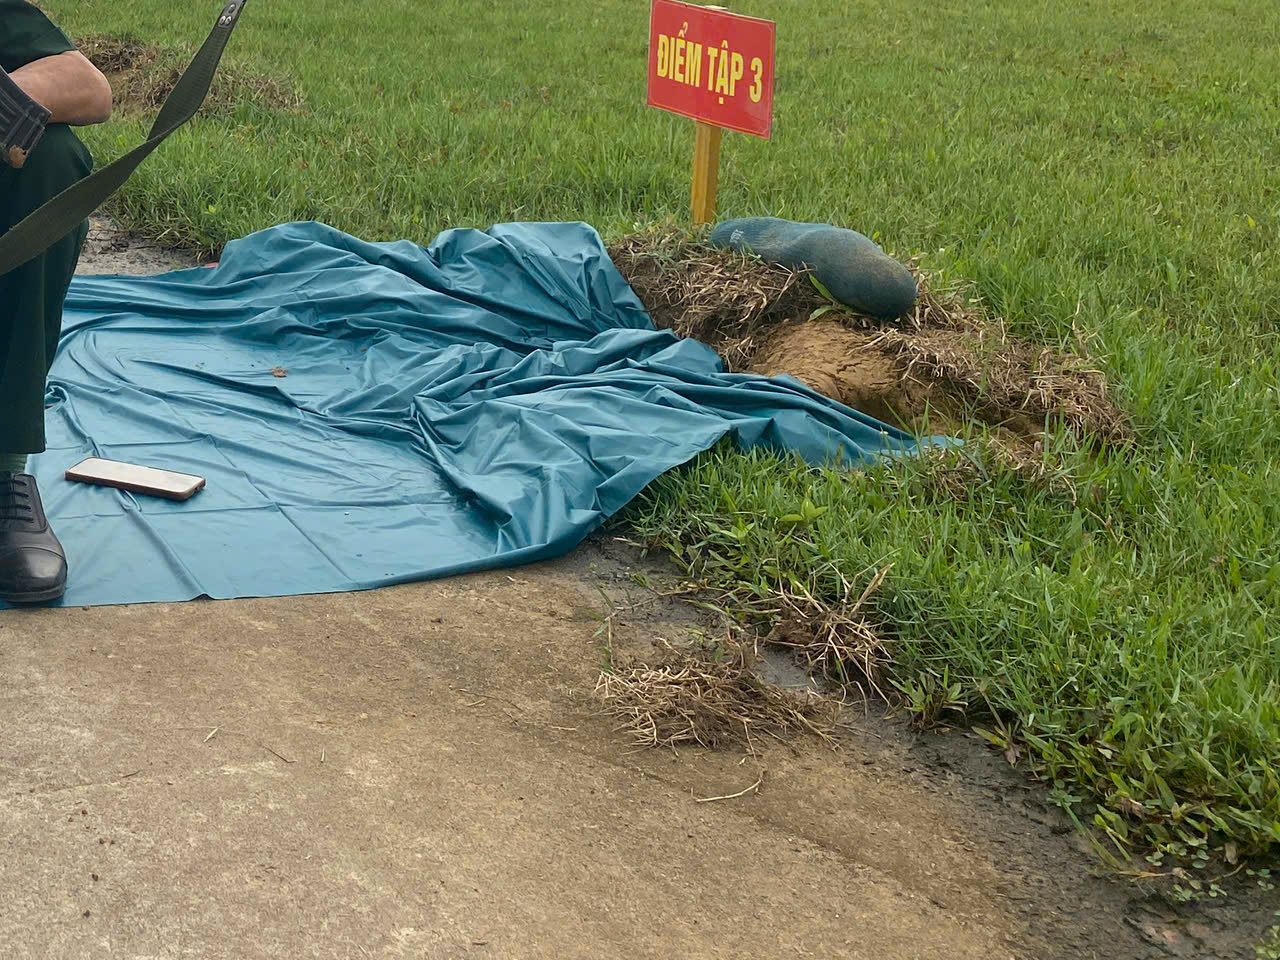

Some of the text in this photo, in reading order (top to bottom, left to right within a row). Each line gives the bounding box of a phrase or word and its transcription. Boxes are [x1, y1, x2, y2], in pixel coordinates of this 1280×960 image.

[656, 21, 763, 105] ĐIỂM TẬP 3
